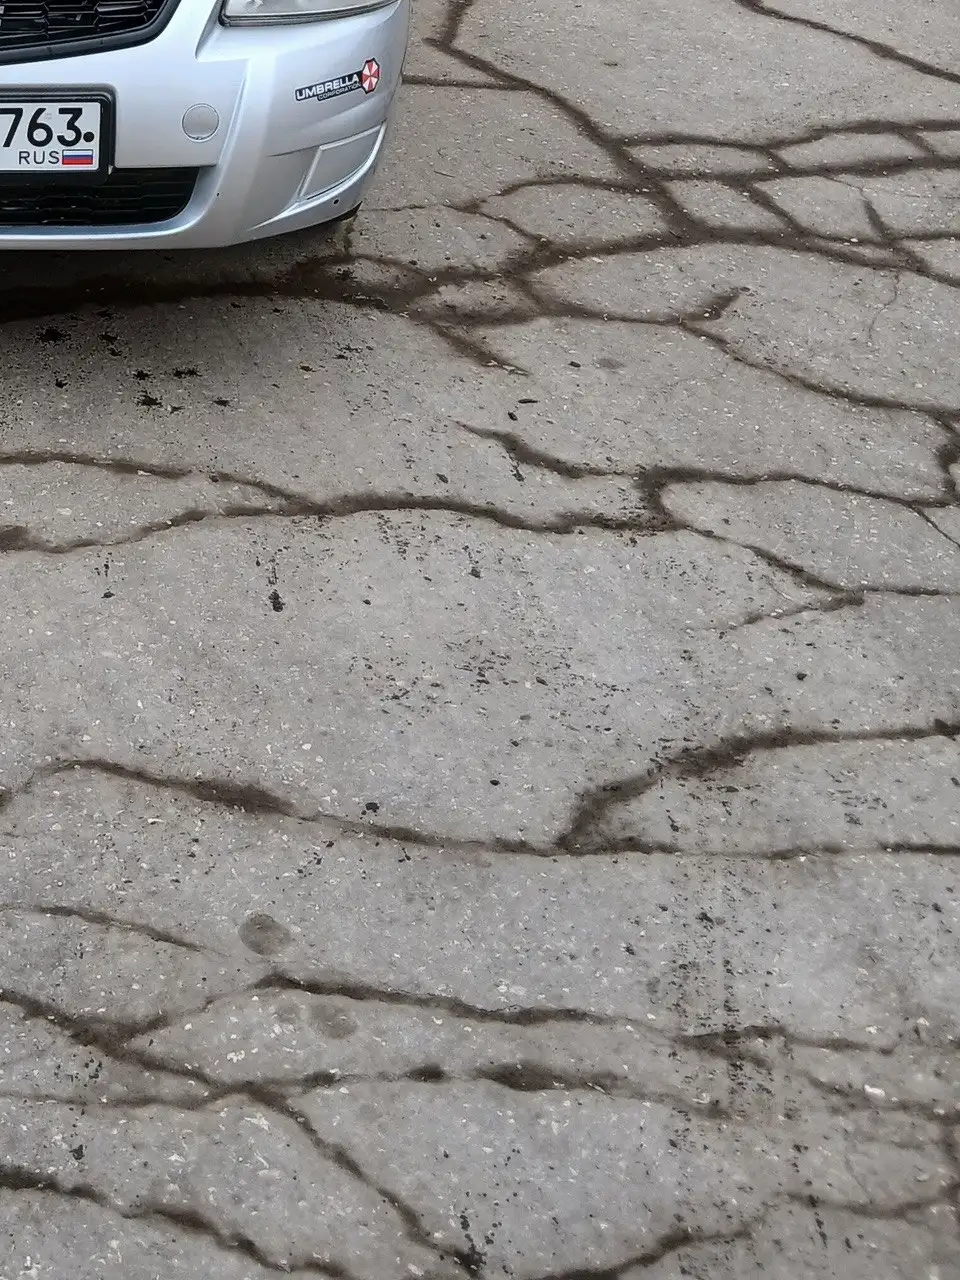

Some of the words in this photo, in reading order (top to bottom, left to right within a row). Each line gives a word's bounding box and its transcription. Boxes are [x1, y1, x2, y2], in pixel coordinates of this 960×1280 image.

[296, 74, 360, 100] UMBRELLA
[318, 82, 361, 100] CORPORATION
[18, 150, 60, 165] RUS
